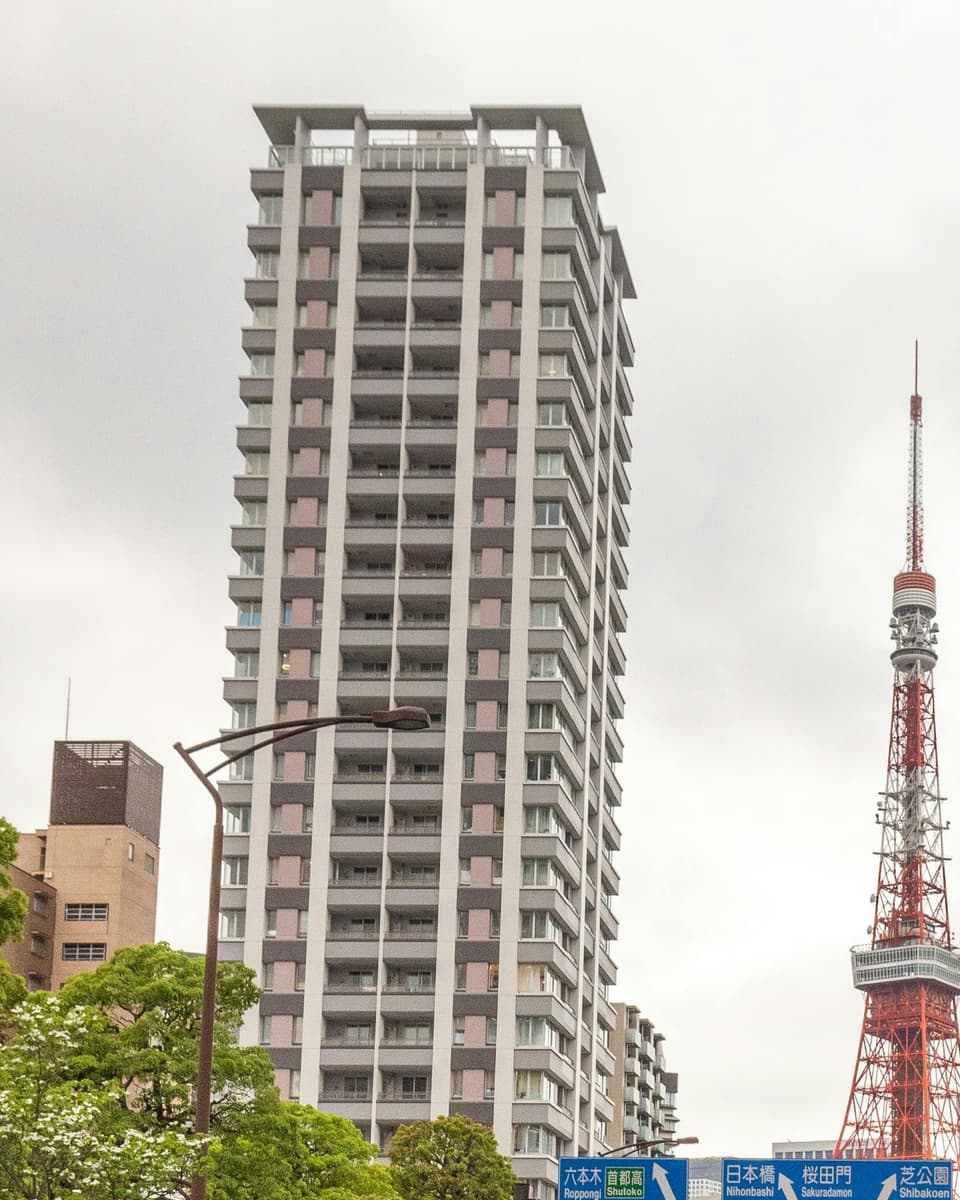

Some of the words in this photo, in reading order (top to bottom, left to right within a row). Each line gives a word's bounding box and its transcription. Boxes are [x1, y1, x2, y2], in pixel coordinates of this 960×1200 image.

[564, 1166, 602, 1186] 六本木
[607, 1170, 643, 1186] 首都高
[726, 1164, 775, 1184] 日本橋
[802, 1165, 852, 1185] 桜田門
[899, 1166, 949, 1186] 芝公園
[564, 1188, 602, 1200] Roppongi
[607, 1187, 643, 1196] Shutoko
[726, 1186, 774, 1197] Nihonbashi
[801, 1187, 853, 1198] Sakuradamon
[899, 1187, 950, 1199] Shibakoen
